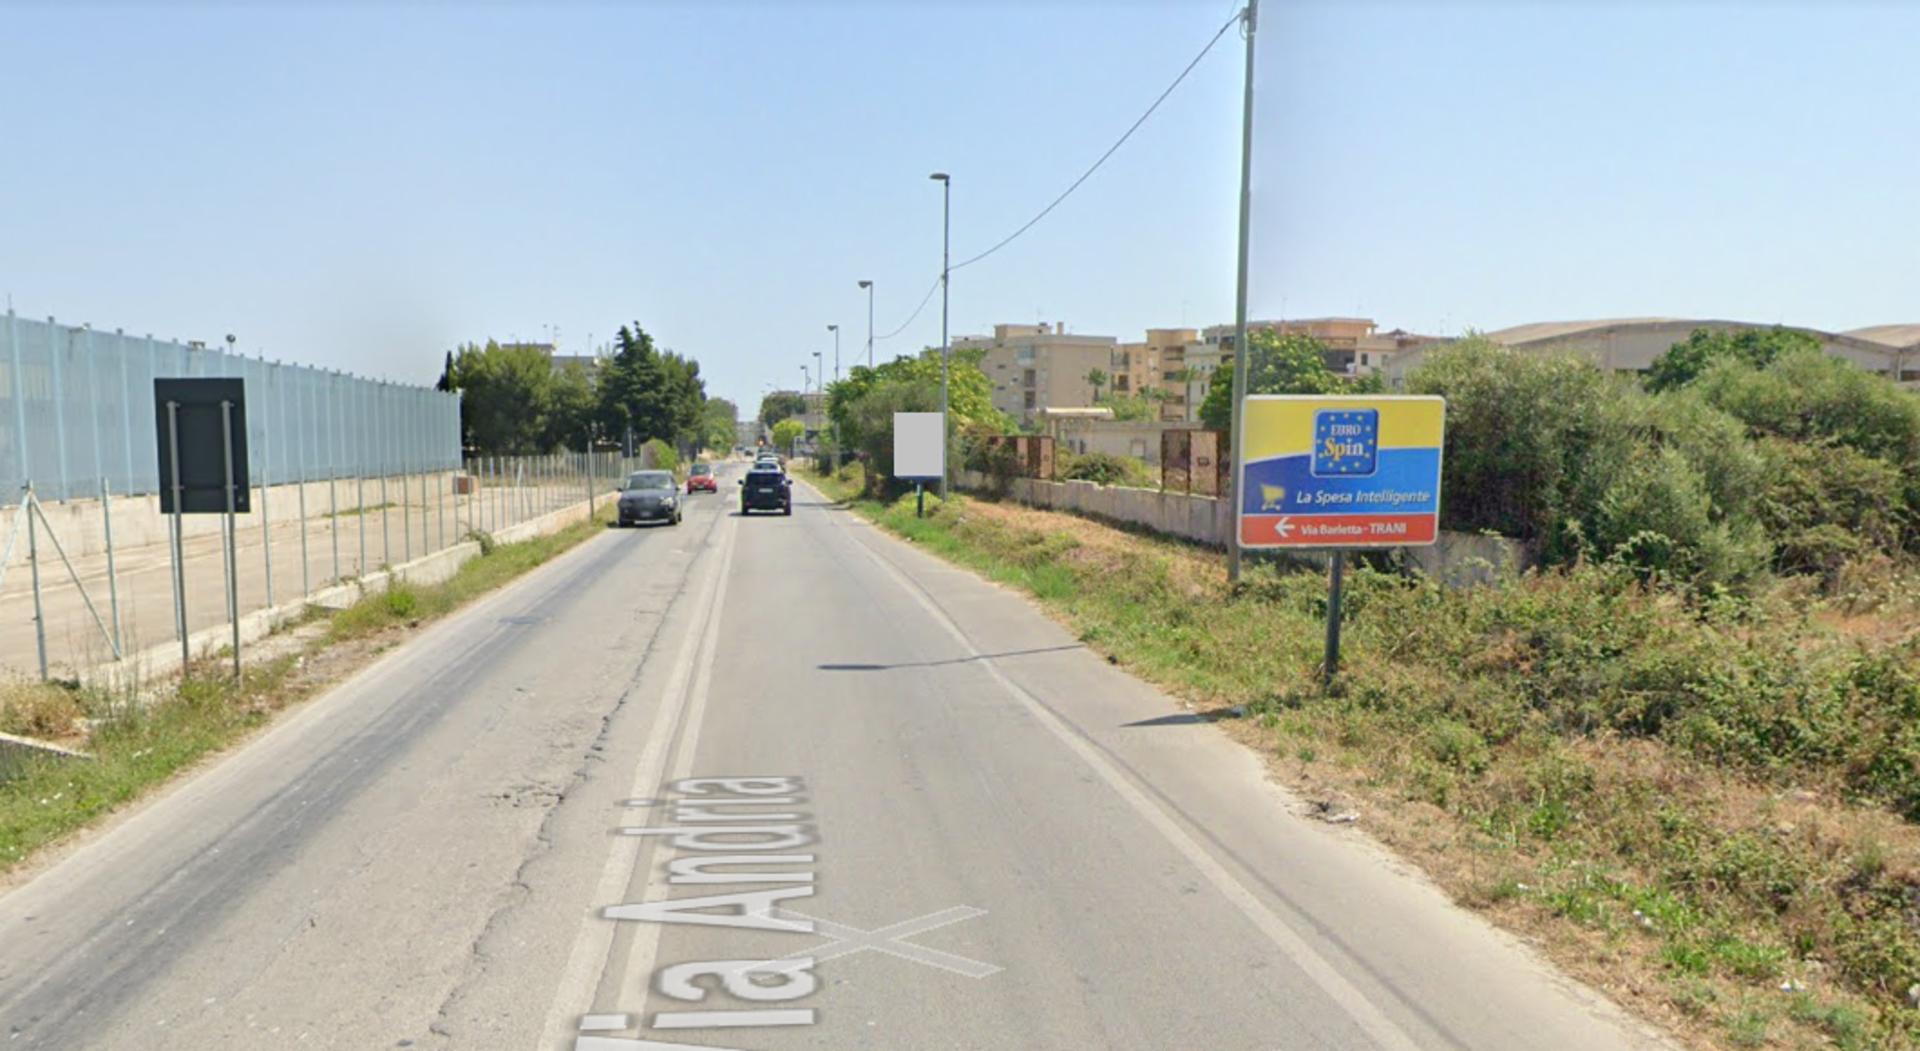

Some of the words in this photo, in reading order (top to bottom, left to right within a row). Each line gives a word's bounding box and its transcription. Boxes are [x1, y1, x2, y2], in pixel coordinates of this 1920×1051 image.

[1323, 437, 1364, 461] Spin
[1296, 490, 1312, 504] La
[1315, 490, 1353, 506] Spesa
[1356, 489, 1430, 505] Intelligente
[1301, 524, 1318, 535] Via
[1369, 522, 1407, 535] TRANI
